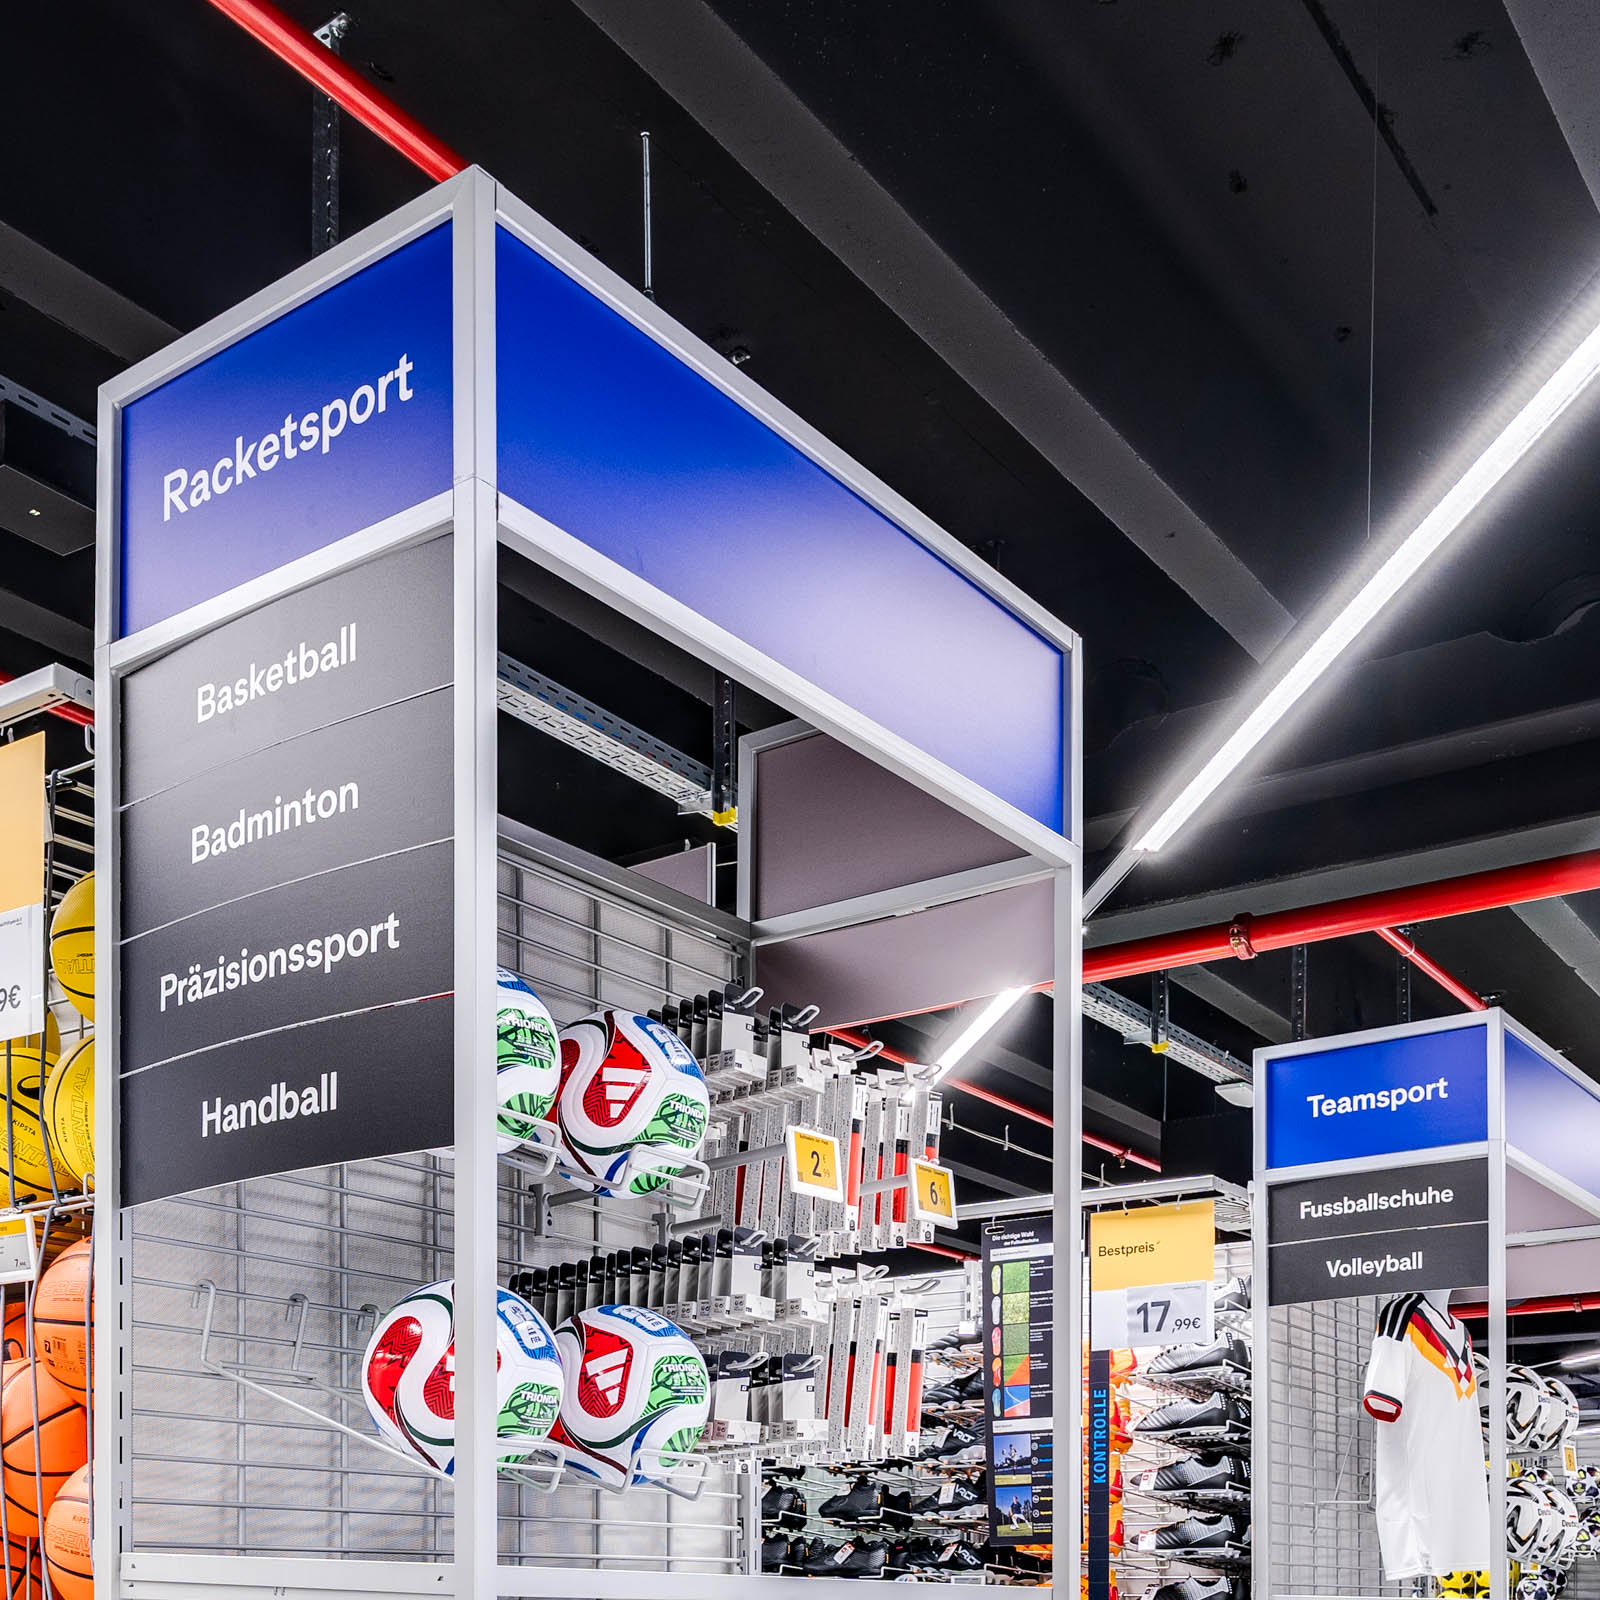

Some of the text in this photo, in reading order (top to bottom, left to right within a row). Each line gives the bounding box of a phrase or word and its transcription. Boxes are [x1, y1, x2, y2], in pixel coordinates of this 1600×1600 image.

[163, 353, 415, 521] Racketsport
[196, 623, 357, 724] Basketball
[190, 781, 359, 865] Badminton
[159, 911, 401, 1013] Präzisionssport
[507, 1015, 550, 1036] TRIONDA
[201, 1071, 338, 1138] Handball
[669, 1100, 704, 1119] TRIONDA
[1306, 1076, 1449, 1119] Teamsport
[811, 1151, 822, 1178] 2
[929, 1181, 938, 1205] 6
[1300, 1185, 1454, 1220] Fussballschuhe
[1098, 1242, 1155, 1259] Bestpreis
[1326, 1250, 1423, 1278] Volleyball
[660, 1363, 701, 1374] TRIONDA
[519, 1389, 558, 1405] TRIONDA
[1092, 1388, 1108, 1484] KONTROLLE
